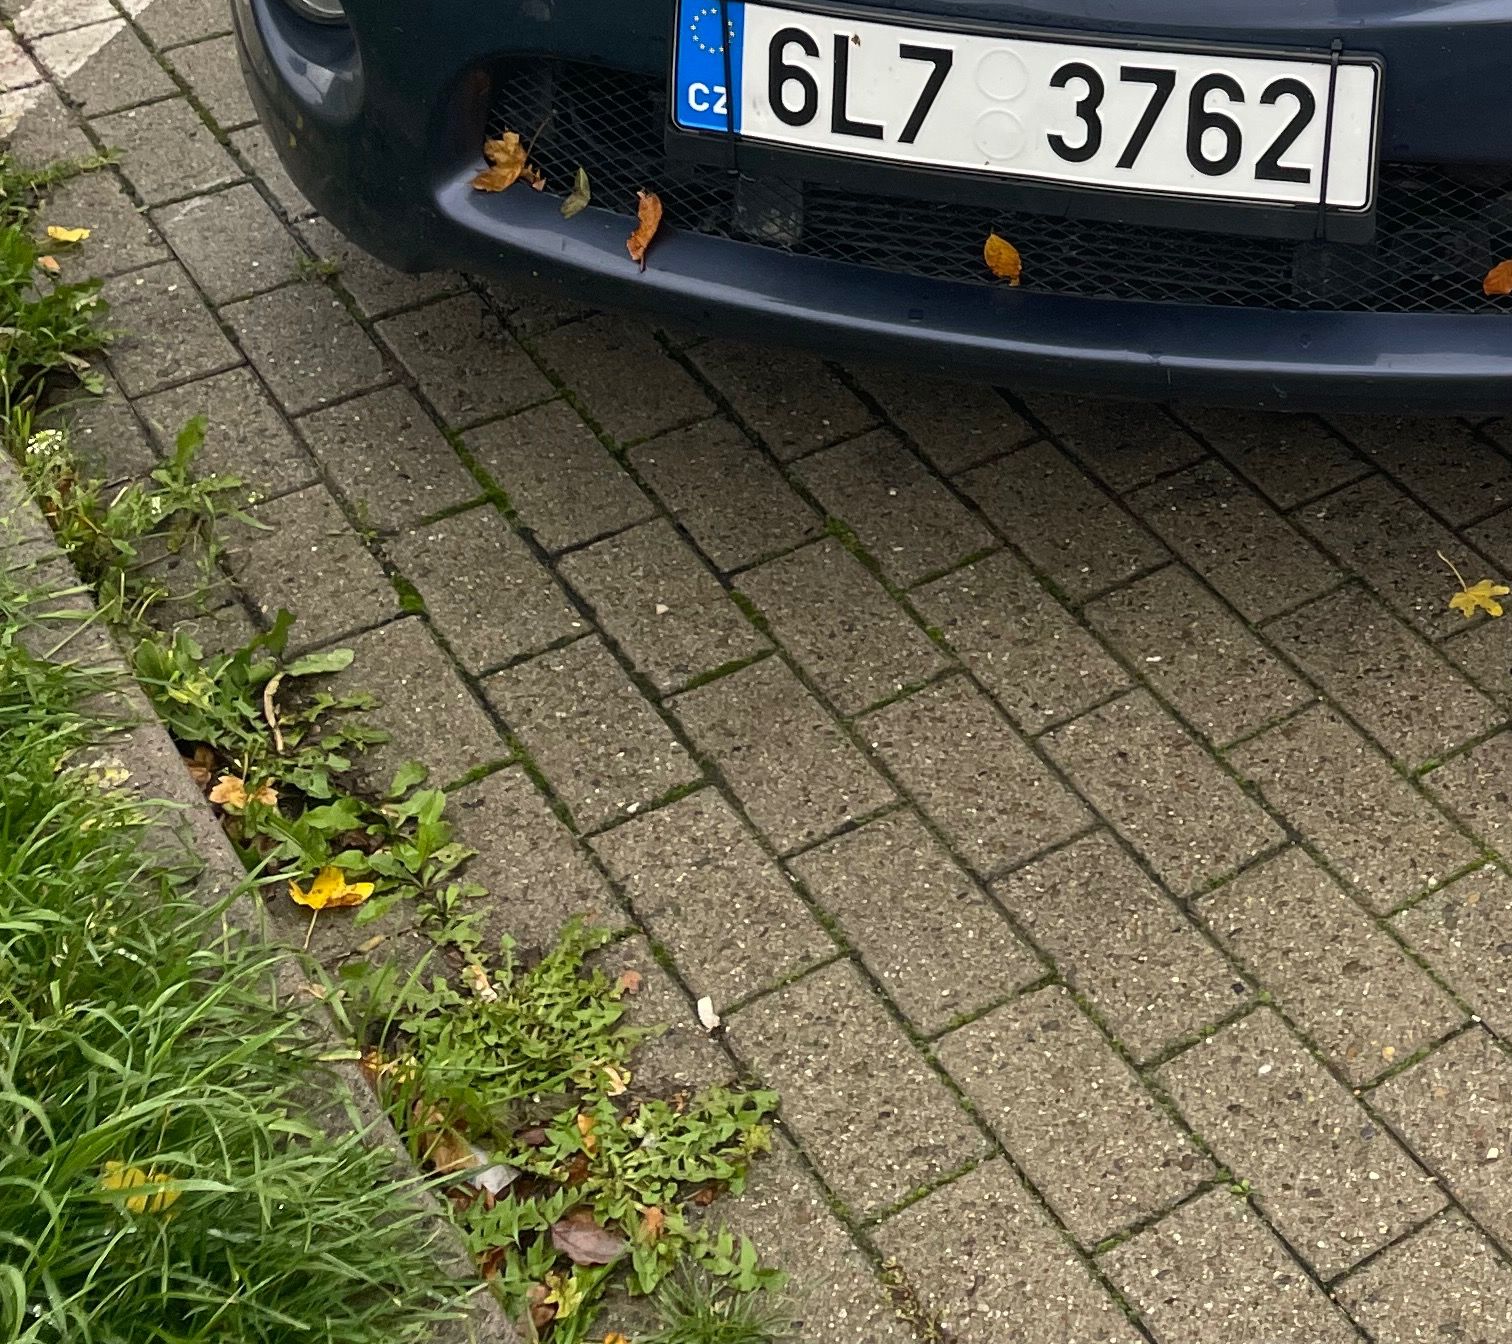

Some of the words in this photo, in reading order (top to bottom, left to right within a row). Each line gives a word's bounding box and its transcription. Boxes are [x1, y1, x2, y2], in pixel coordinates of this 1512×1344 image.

[688, 82, 728, 115] CZ
[768, 27, 953, 144] 6L7
[1047, 62, 1316, 184] 3762
